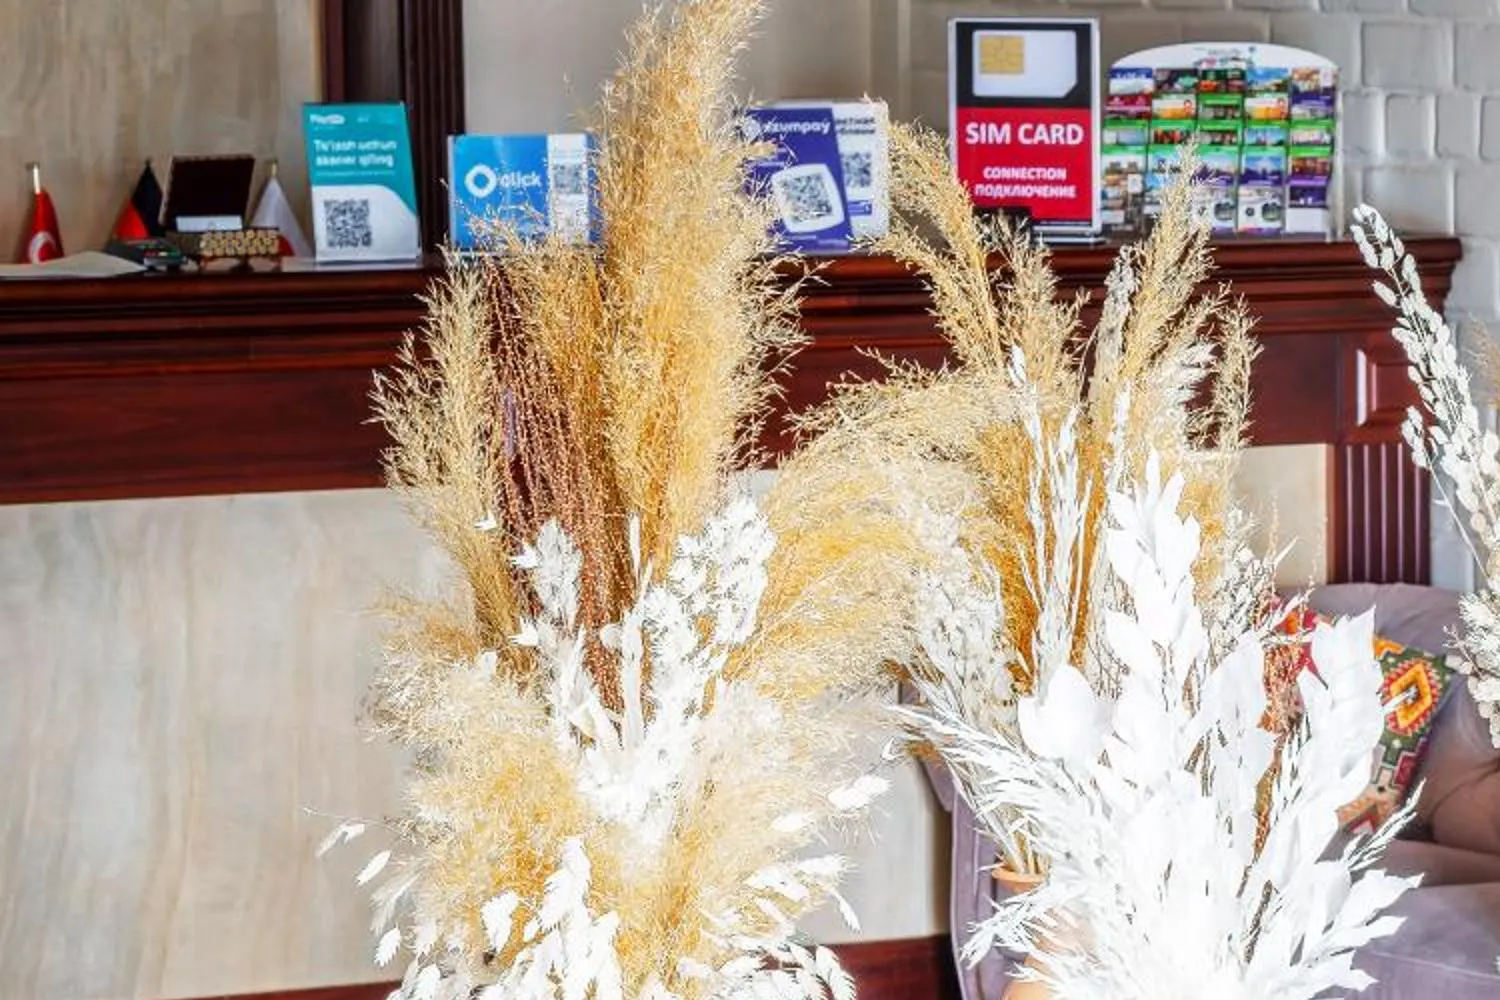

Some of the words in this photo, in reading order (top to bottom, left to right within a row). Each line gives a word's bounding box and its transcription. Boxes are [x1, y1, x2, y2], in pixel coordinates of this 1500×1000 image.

[965, 122, 1011, 145] SIM
[1017, 123, 1084, 145] CARD
[983, 166, 1066, 180] CONNECTION
[975, 184, 1076, 198] ПОДКЛЮЧЕНИЕ
